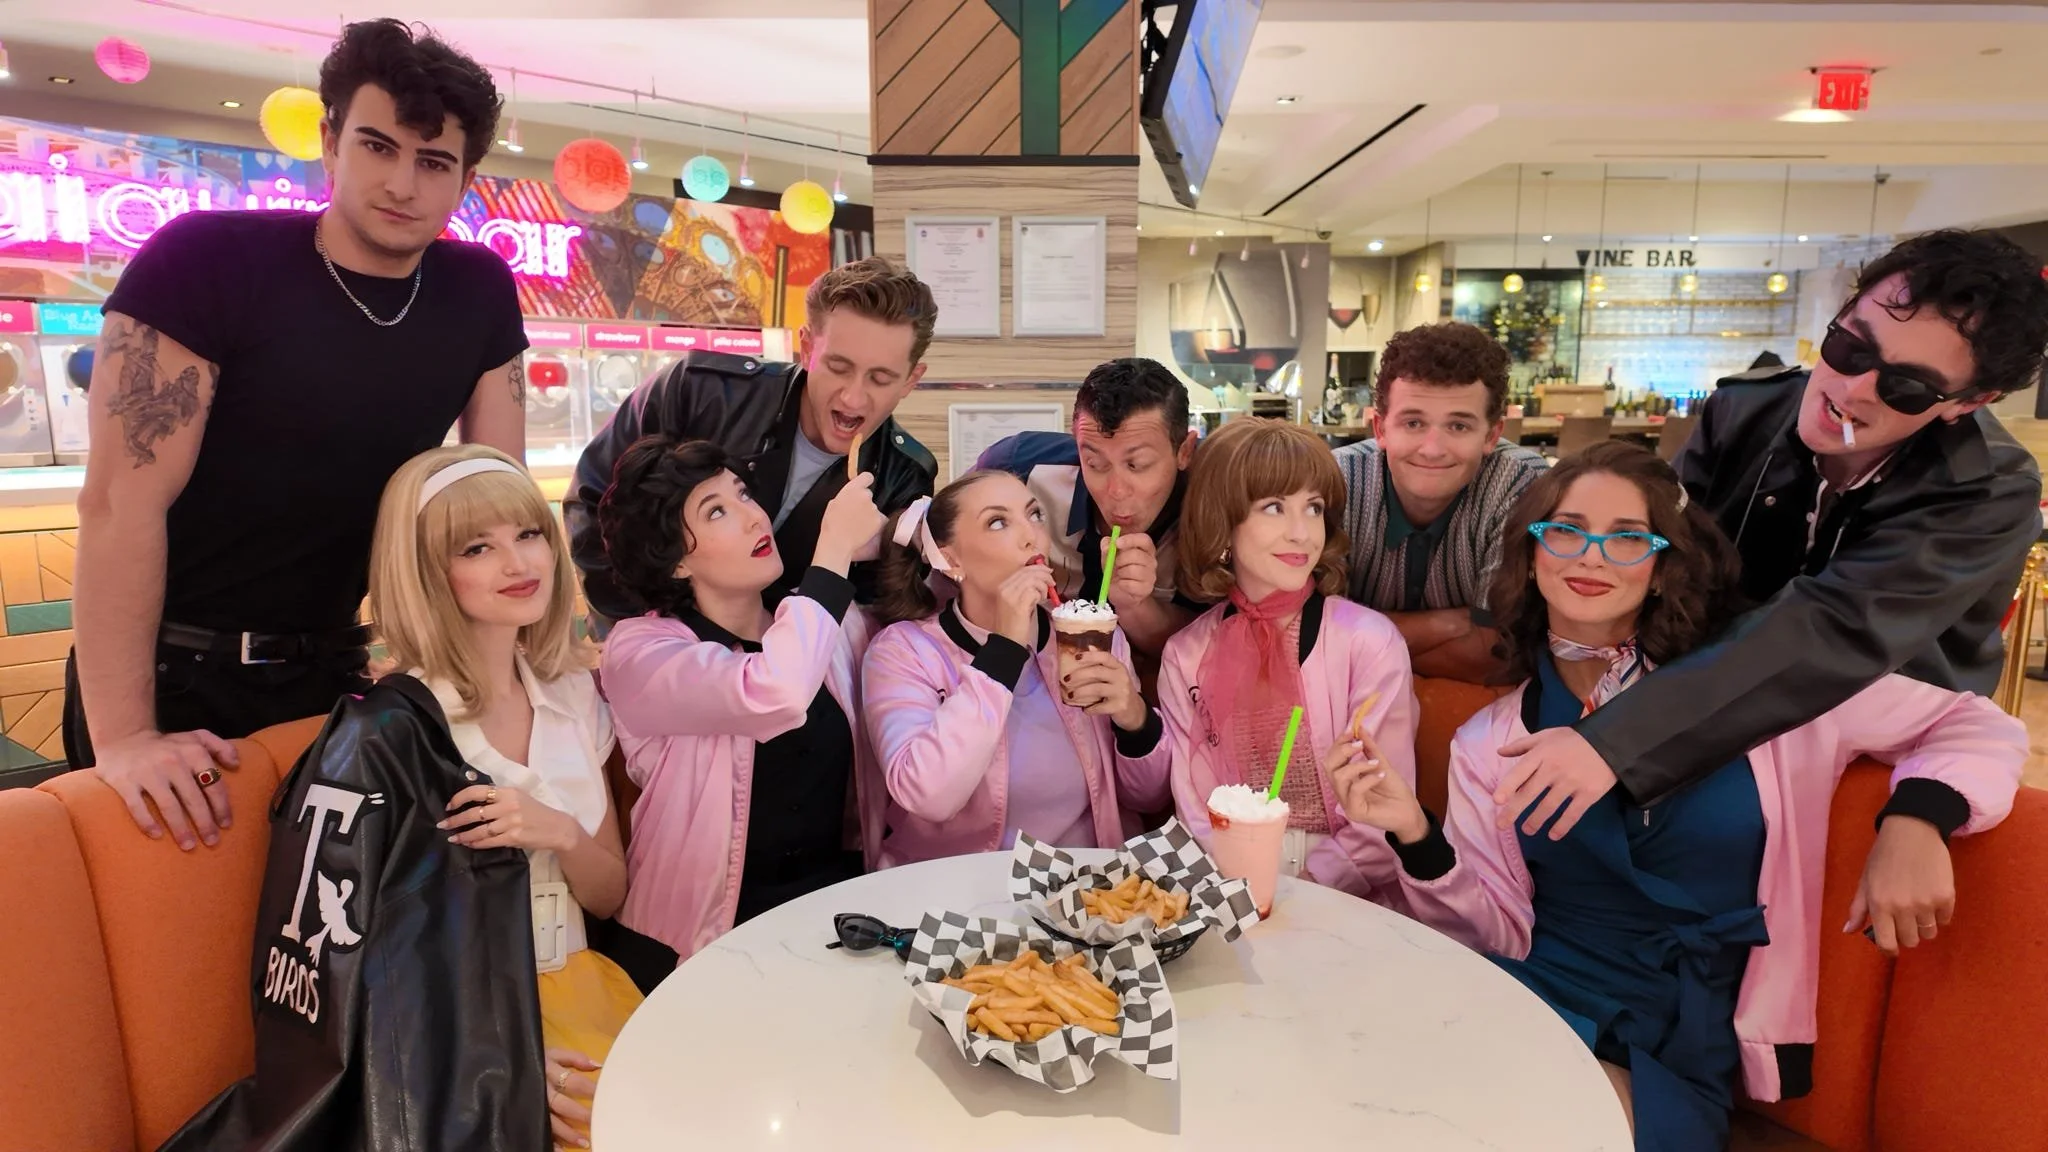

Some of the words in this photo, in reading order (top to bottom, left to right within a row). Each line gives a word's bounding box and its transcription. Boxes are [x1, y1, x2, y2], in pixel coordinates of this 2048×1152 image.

[1820, 73, 1868, 111] EXIT
[448, 215, 582, 277] ar
[1646, 249, 1696, 267] BAR
[594, 331, 641, 344] strawberry
[664, 335, 696, 347] mango
[264, 946, 320, 1024] BIRDS
